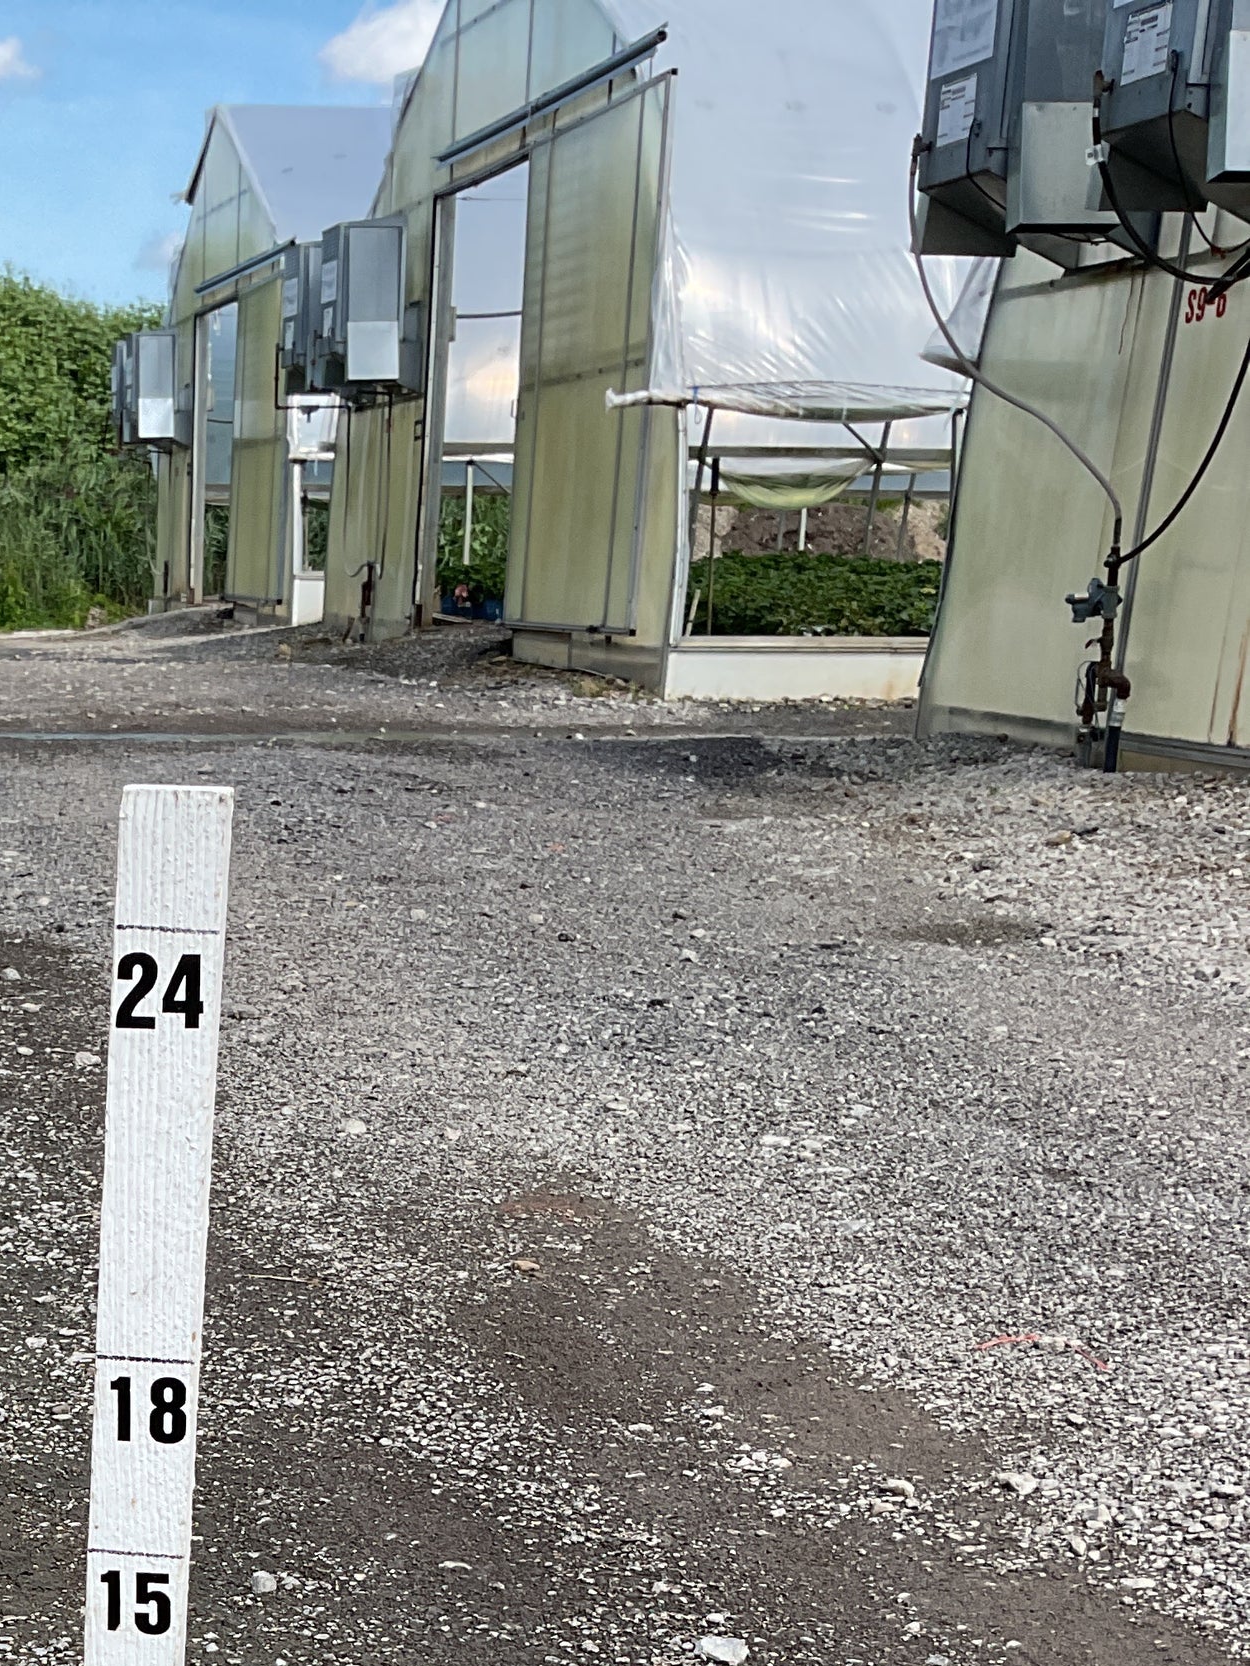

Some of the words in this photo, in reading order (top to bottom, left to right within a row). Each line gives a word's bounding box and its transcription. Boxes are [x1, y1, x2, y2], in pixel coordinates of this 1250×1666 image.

[116, 952, 204, 1029] 24
[110, 1376, 187, 1444] 18
[100, 1570, 172, 1635] 15
